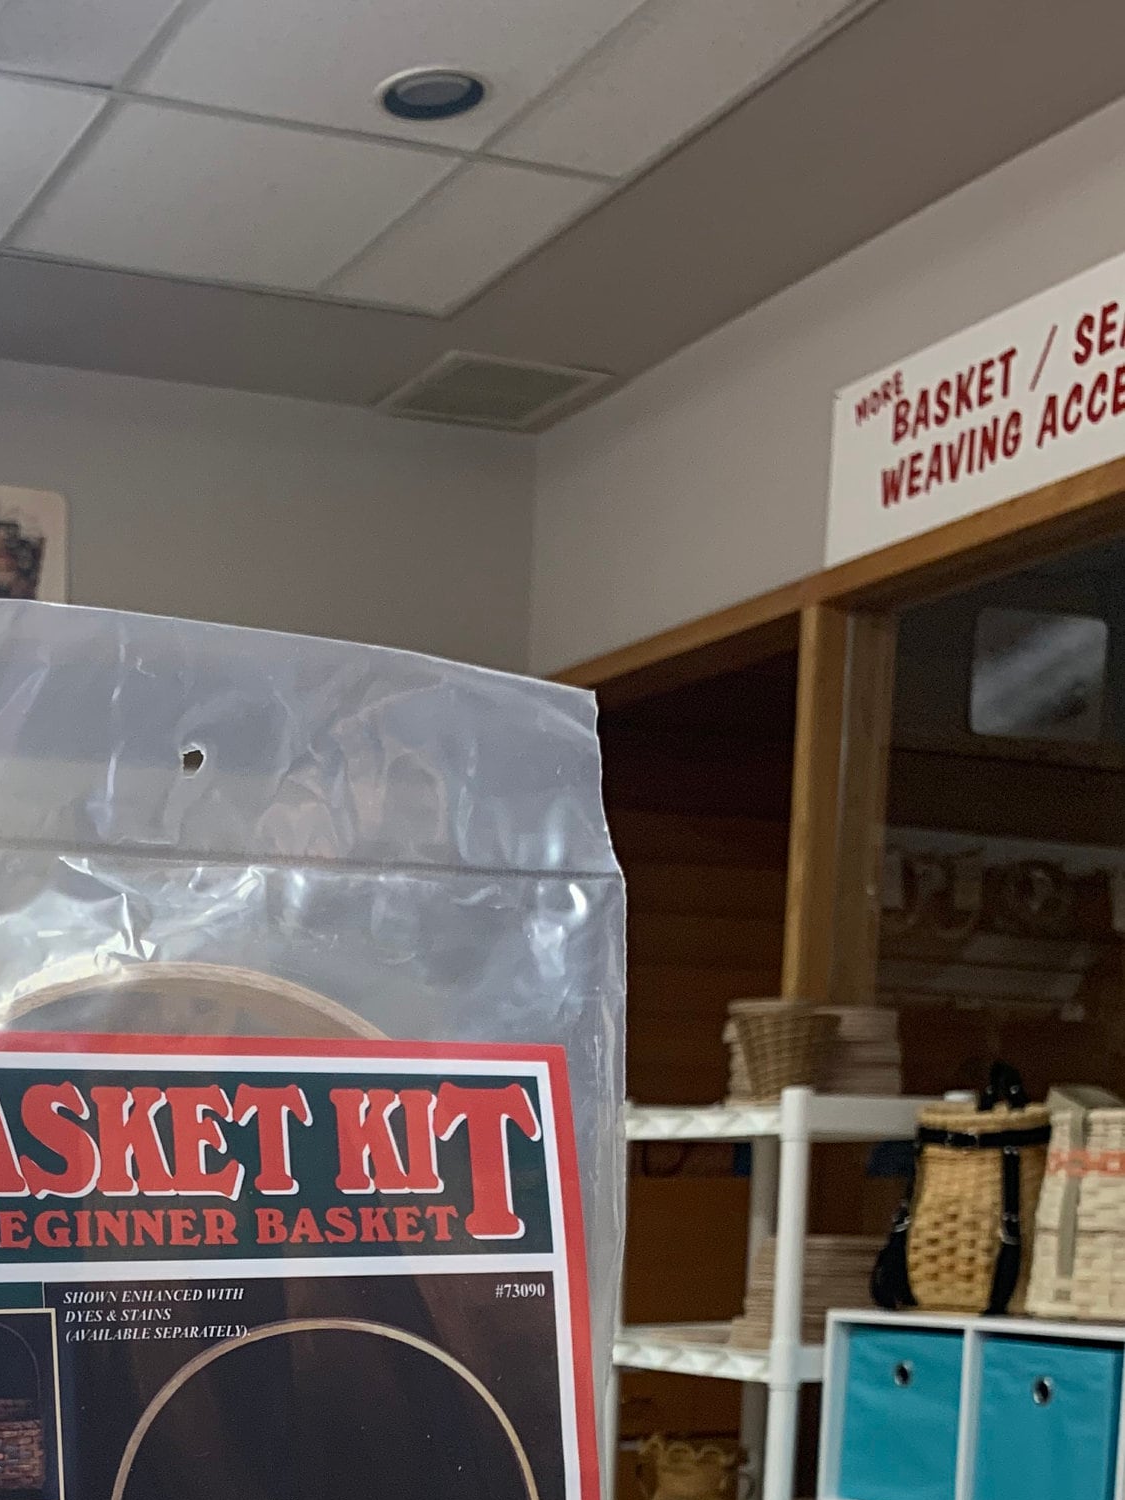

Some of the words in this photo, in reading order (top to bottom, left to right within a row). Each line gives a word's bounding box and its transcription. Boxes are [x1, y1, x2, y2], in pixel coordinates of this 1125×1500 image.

[892, 347, 1018, 445] BASKET
[1073, 302, 1125, 365] SE
[855, 370, 903, 426] MORE
[881, 411, 1022, 508] WEAVING
[329, 1081, 542, 1240] KIT
[255, 1204, 459, 1245] BASKET
[63, 1291, 118, 1304] SHOWN
[122, 1288, 203, 1303] ENHANCED
[206, 1287, 245, 1301] WITH
[494, 1283, 546, 1299] #73090
[64, 1309, 103, 1323] DYES
[106, 1309, 118, 1322] &
[120, 1308, 172, 1321] STAINS
[65, 1327, 150, 1343] (AVAILABLE
[153, 1325, 251, 1339] SEPARATELY).
